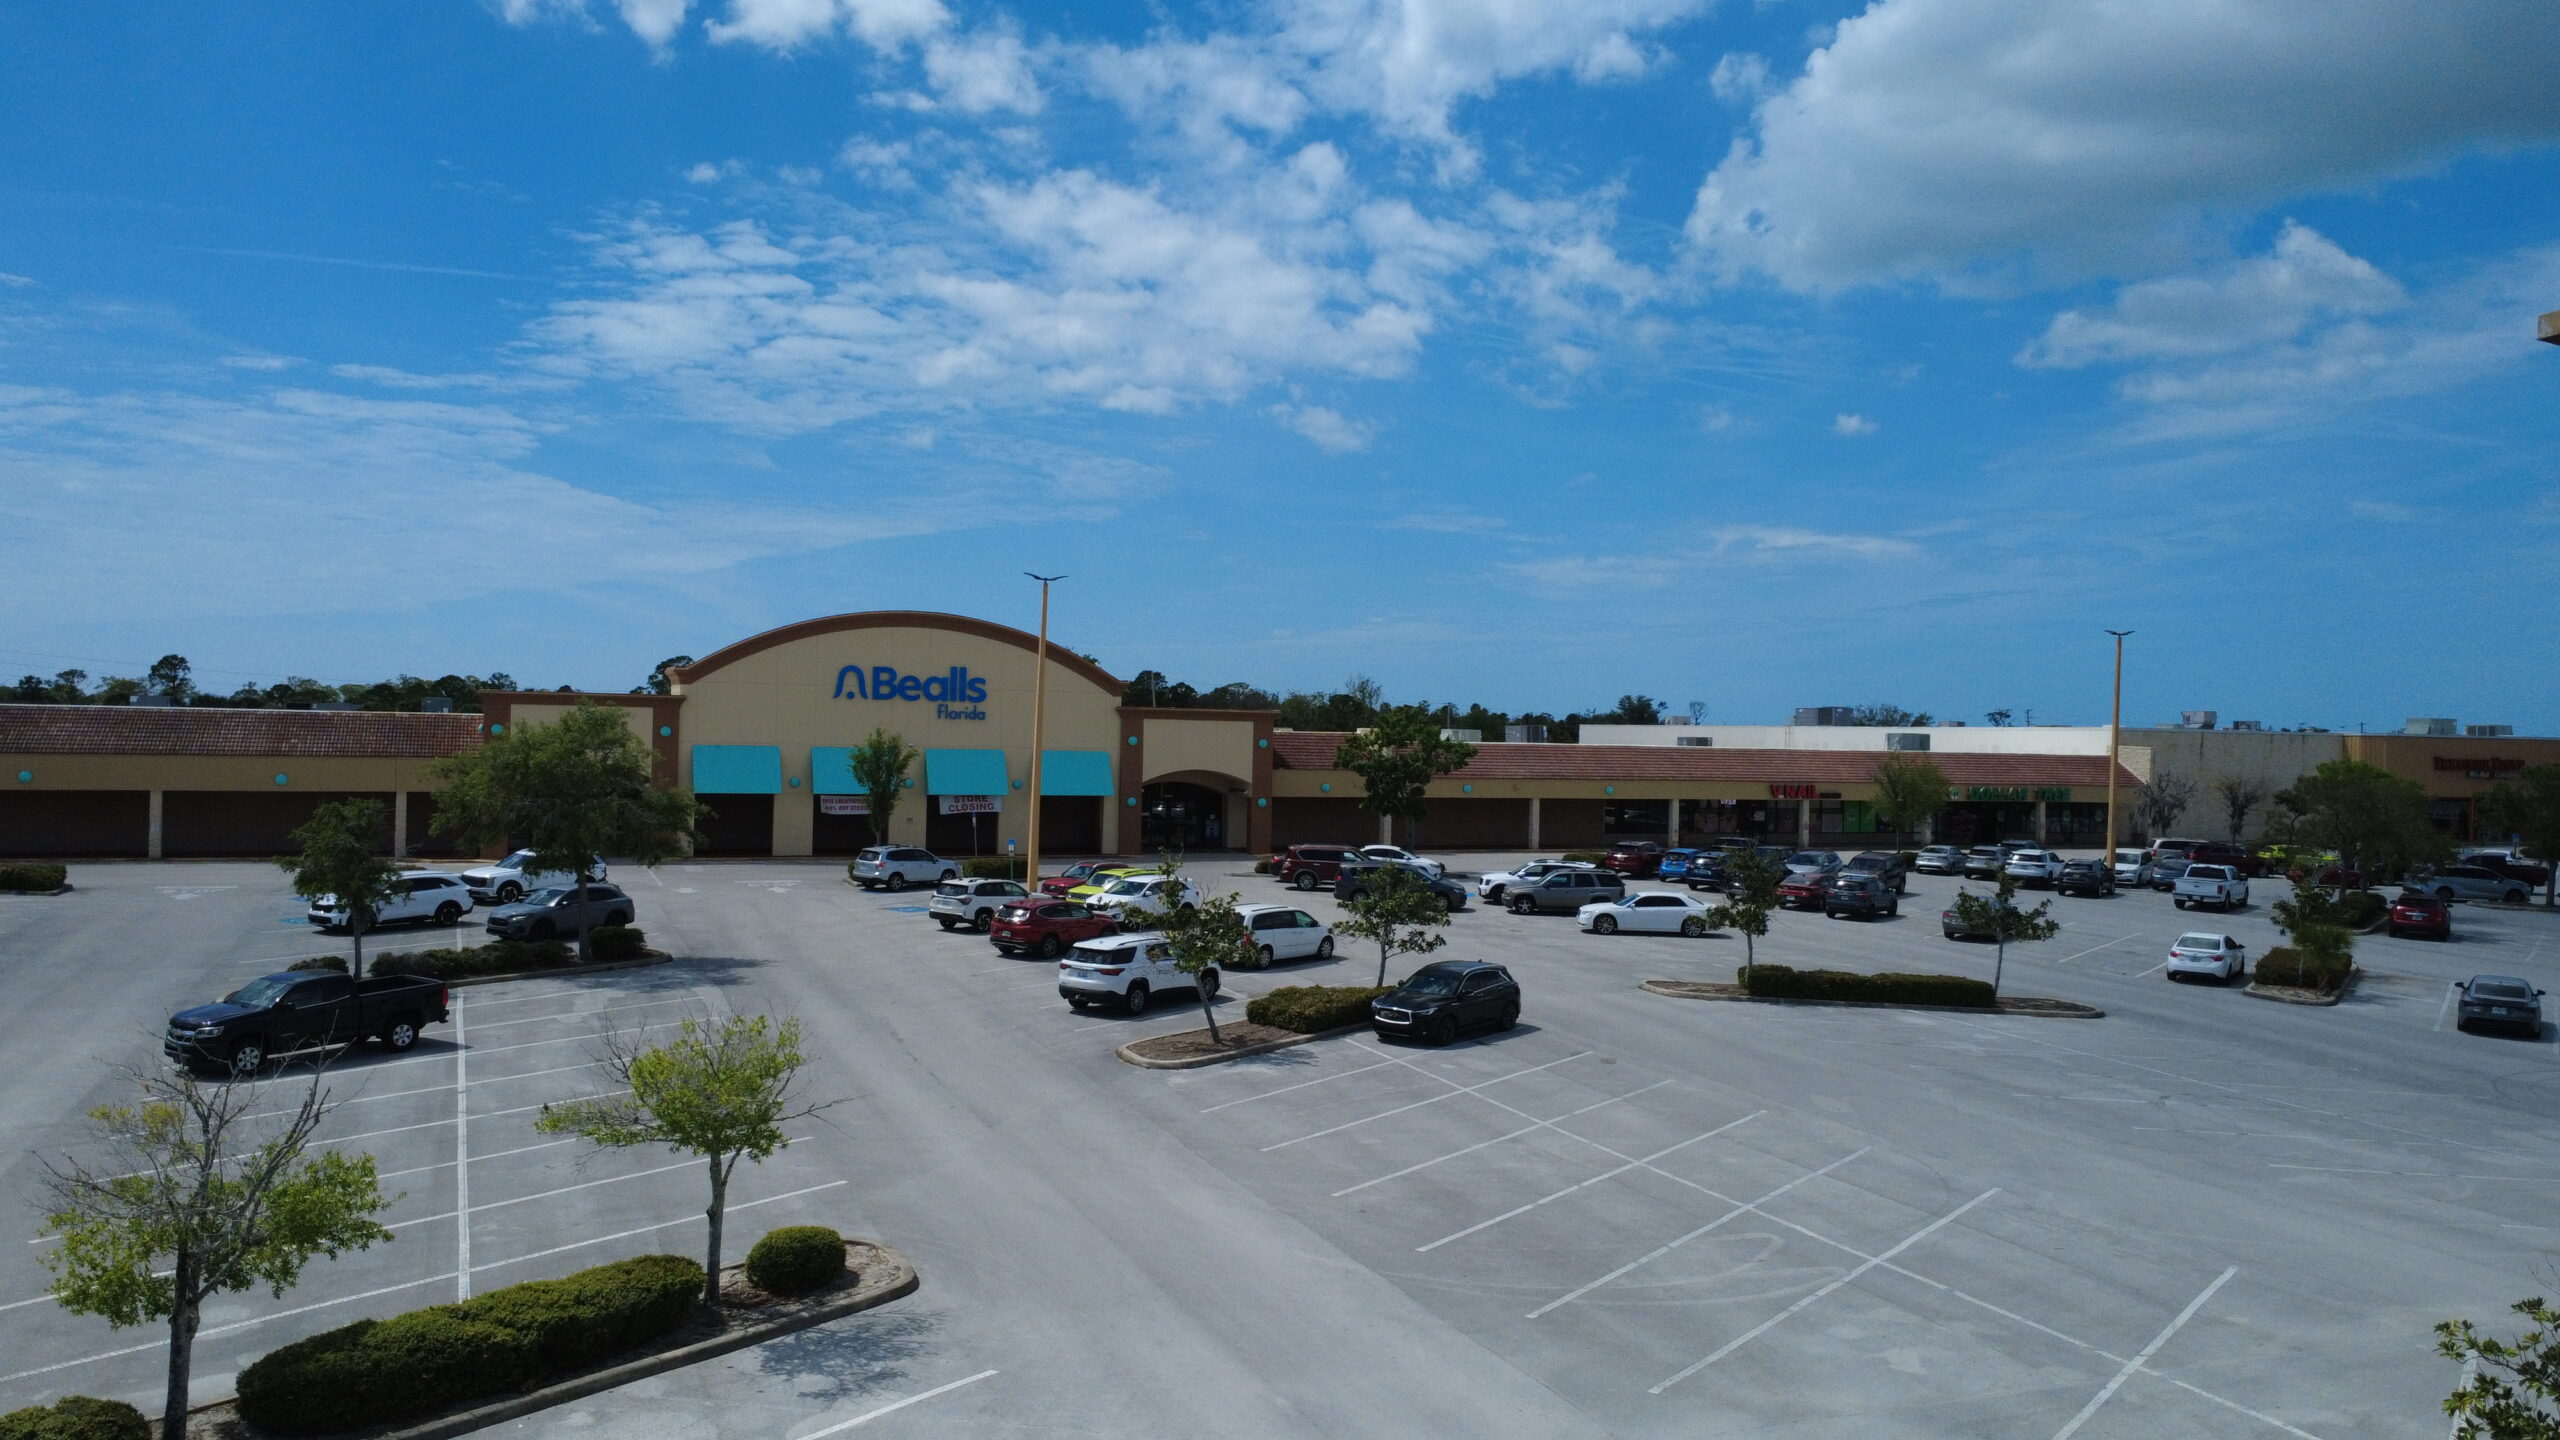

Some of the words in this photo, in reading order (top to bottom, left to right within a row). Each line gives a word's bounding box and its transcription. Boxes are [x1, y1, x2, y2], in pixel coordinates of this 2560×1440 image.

[872, 666, 987, 703] Bealls
[1784, 784, 1821, 799] NAIL
[1969, 786, 2029, 800] DOLLAR
[2036, 786, 2071, 800] TREE
[953, 795, 989, 803] STORE
[948, 802, 995, 812] CLOSING
